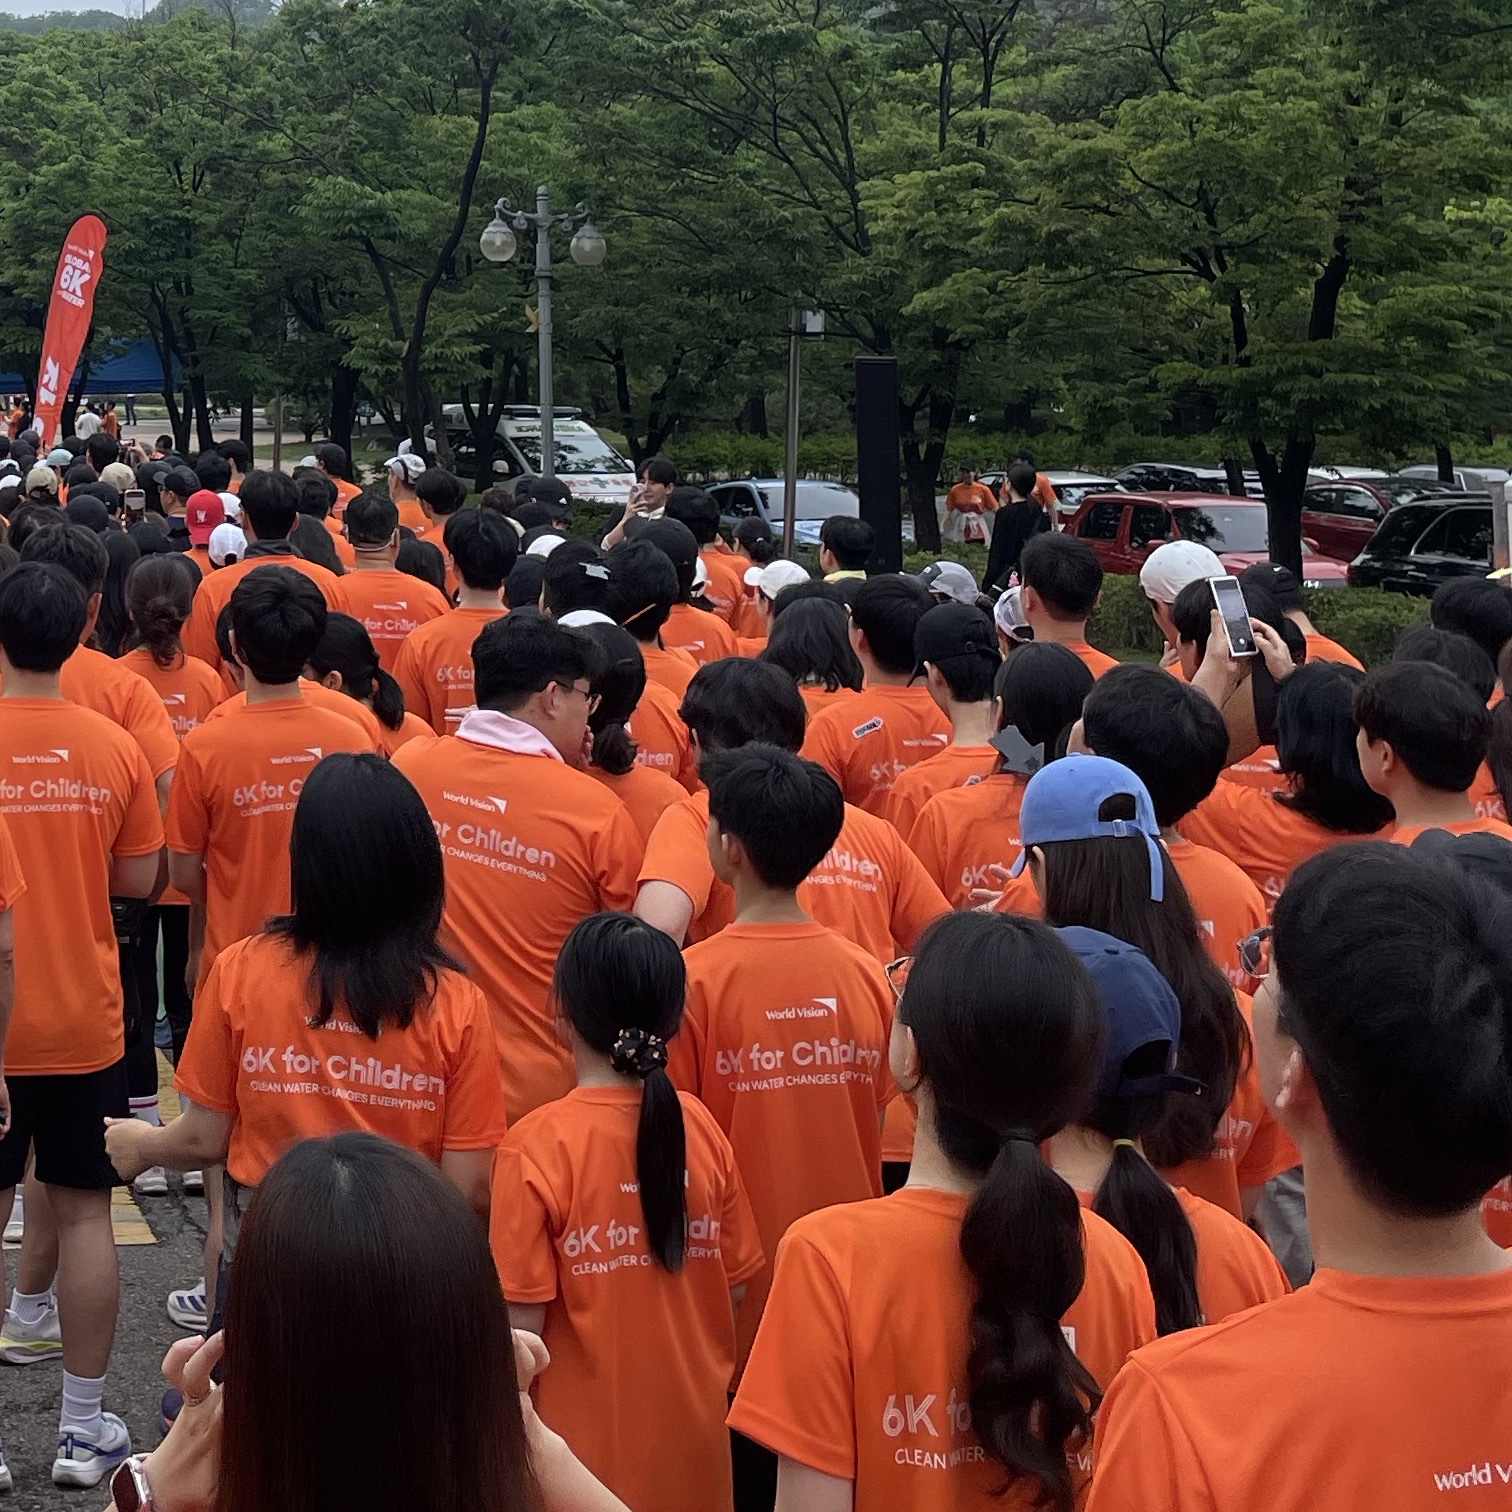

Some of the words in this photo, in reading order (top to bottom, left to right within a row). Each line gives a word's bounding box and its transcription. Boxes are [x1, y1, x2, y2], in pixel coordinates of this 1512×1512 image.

[59, 264, 92, 297] 6K
[436, 666, 455, 682] 6K
[29, 777, 112, 803] Children
[233, 784, 260, 807] 6K
[260, 779, 285, 800] for
[442, 790, 469, 805] World
[469, 797, 496, 813] Vision
[431, 820, 451, 838] or
[456, 824, 556, 869] Children
[446, 846, 489, 866] CHANGES
[490, 858, 548, 882] EVERYTHING
[960, 865, 988, 887] 6K
[765, 1007, 796, 1021] World
[798, 1006, 829, 1019] Vision
[241, 1046, 277, 1074] 6K
[281, 1044, 320, 1075] for
[326, 1054, 445, 1096] Children
[714, 1046, 745, 1076] 6K
[749, 1042, 785, 1071] for
[249, 1080, 282, 1094] CLEAN
[282, 1082, 319, 1094] WATER
[320, 1086, 369, 1104] CHANGES
[369, 1093, 437, 1112] EVERYTHING
[751, 1076, 785, 1091] WATER
[785, 1072, 838, 1087] CHANGES
[563, 1223, 603, 1258] 6K
[606, 1218, 640, 1251] for
[571, 1261, 609, 1276] CLEAN
[882, 1394, 939, 1438] 6K
[894, 1447, 947, 1470] CLEAN
[1433, 1461, 1493, 1492] World
